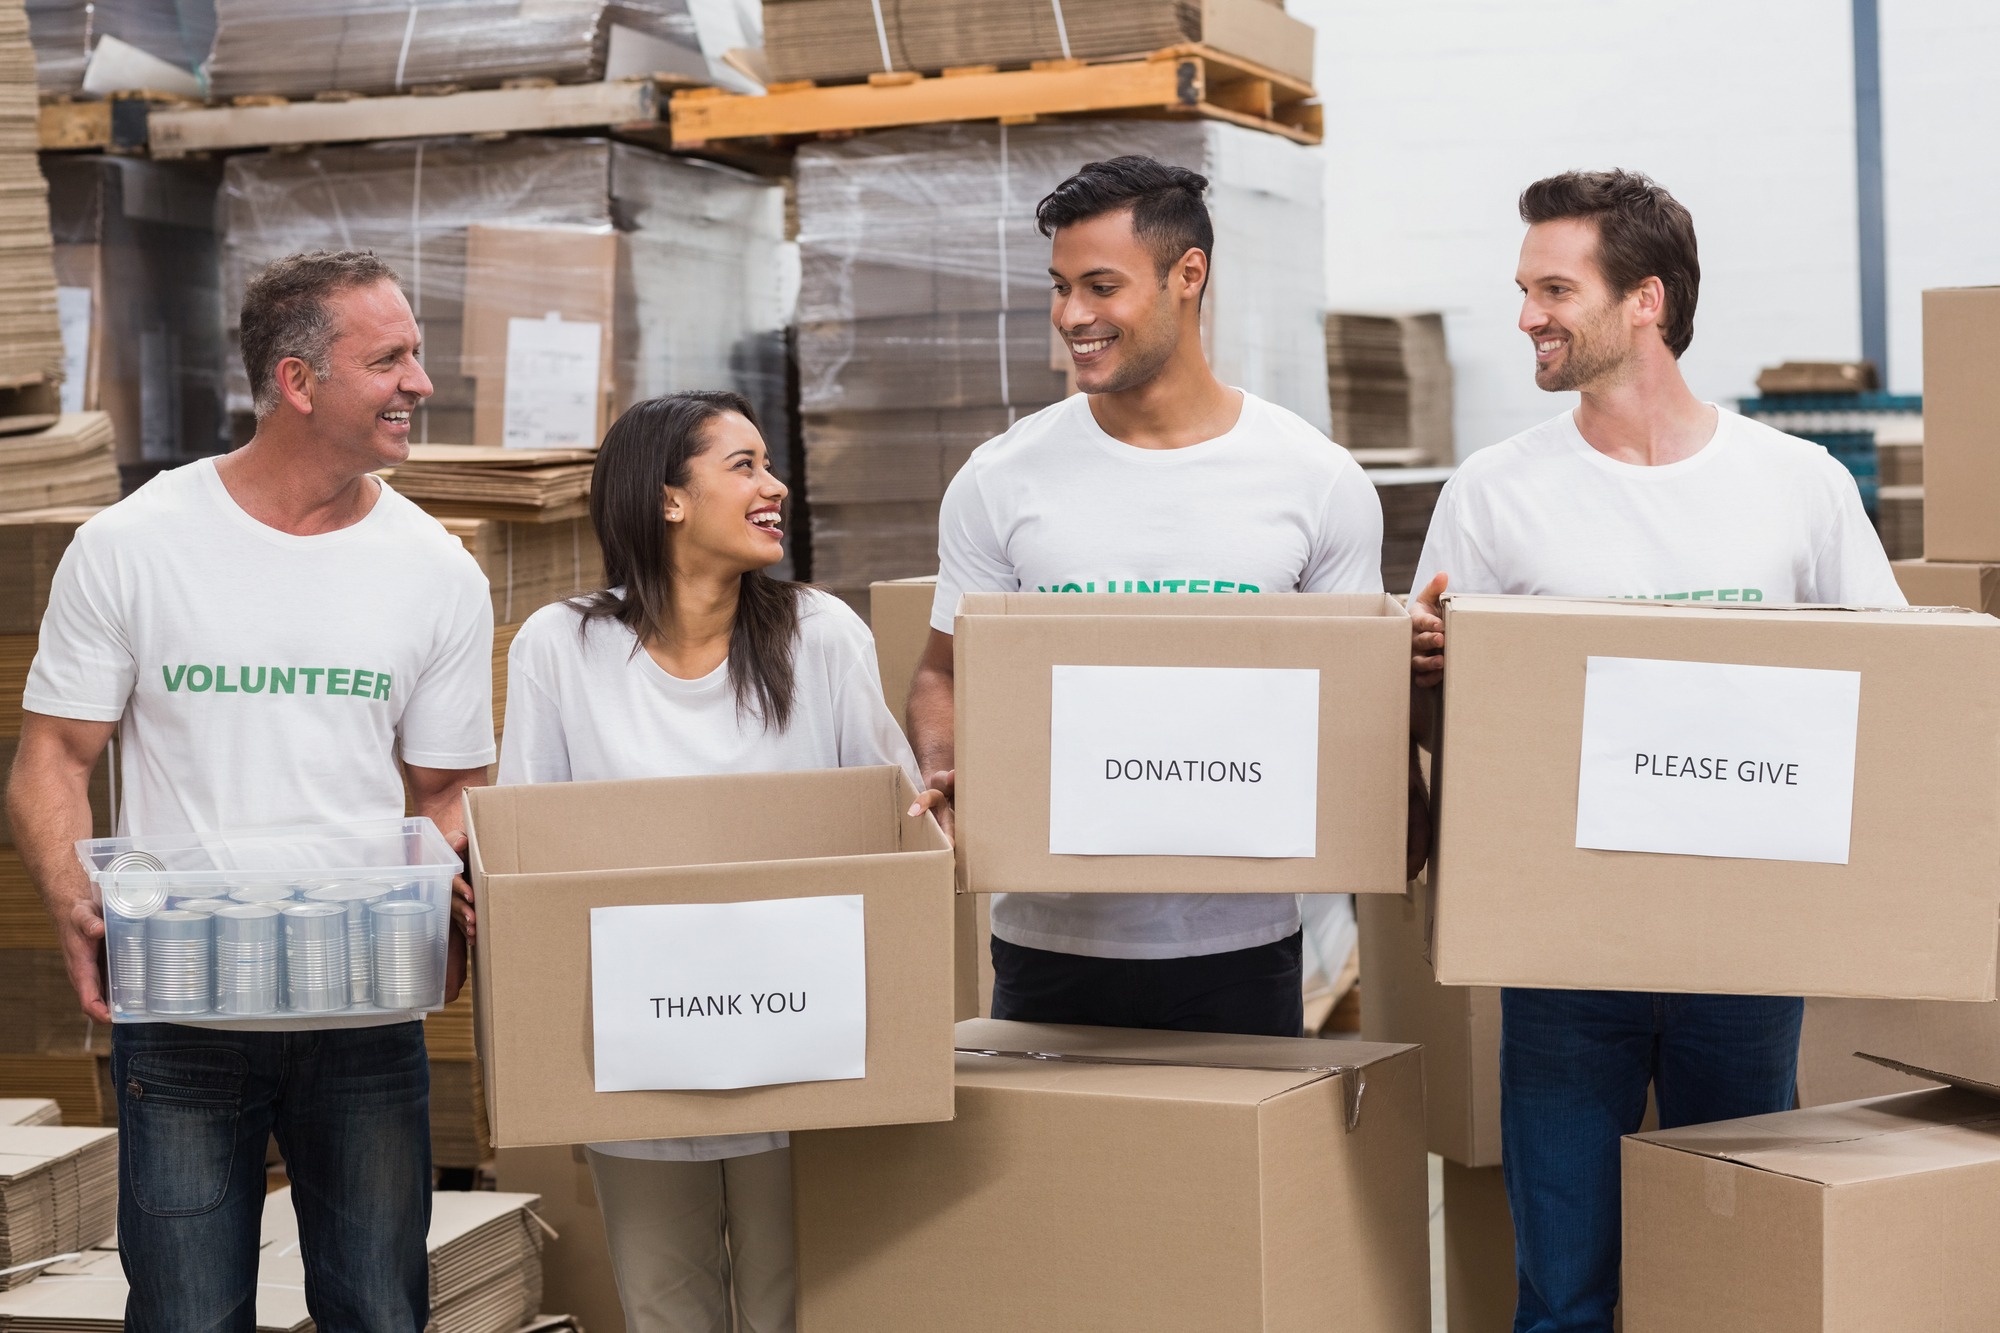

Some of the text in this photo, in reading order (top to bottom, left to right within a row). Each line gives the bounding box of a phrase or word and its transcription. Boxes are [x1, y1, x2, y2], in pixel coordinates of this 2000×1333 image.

[1037, 579, 1261, 594] UNTEE
[162, 664, 392, 701] VOLUNTEER
[1105, 759, 1263, 783] DONATIONS
[1634, 753, 1800, 786] PLEASE GIVE
[649, 991, 807, 1019] THANK YOU
